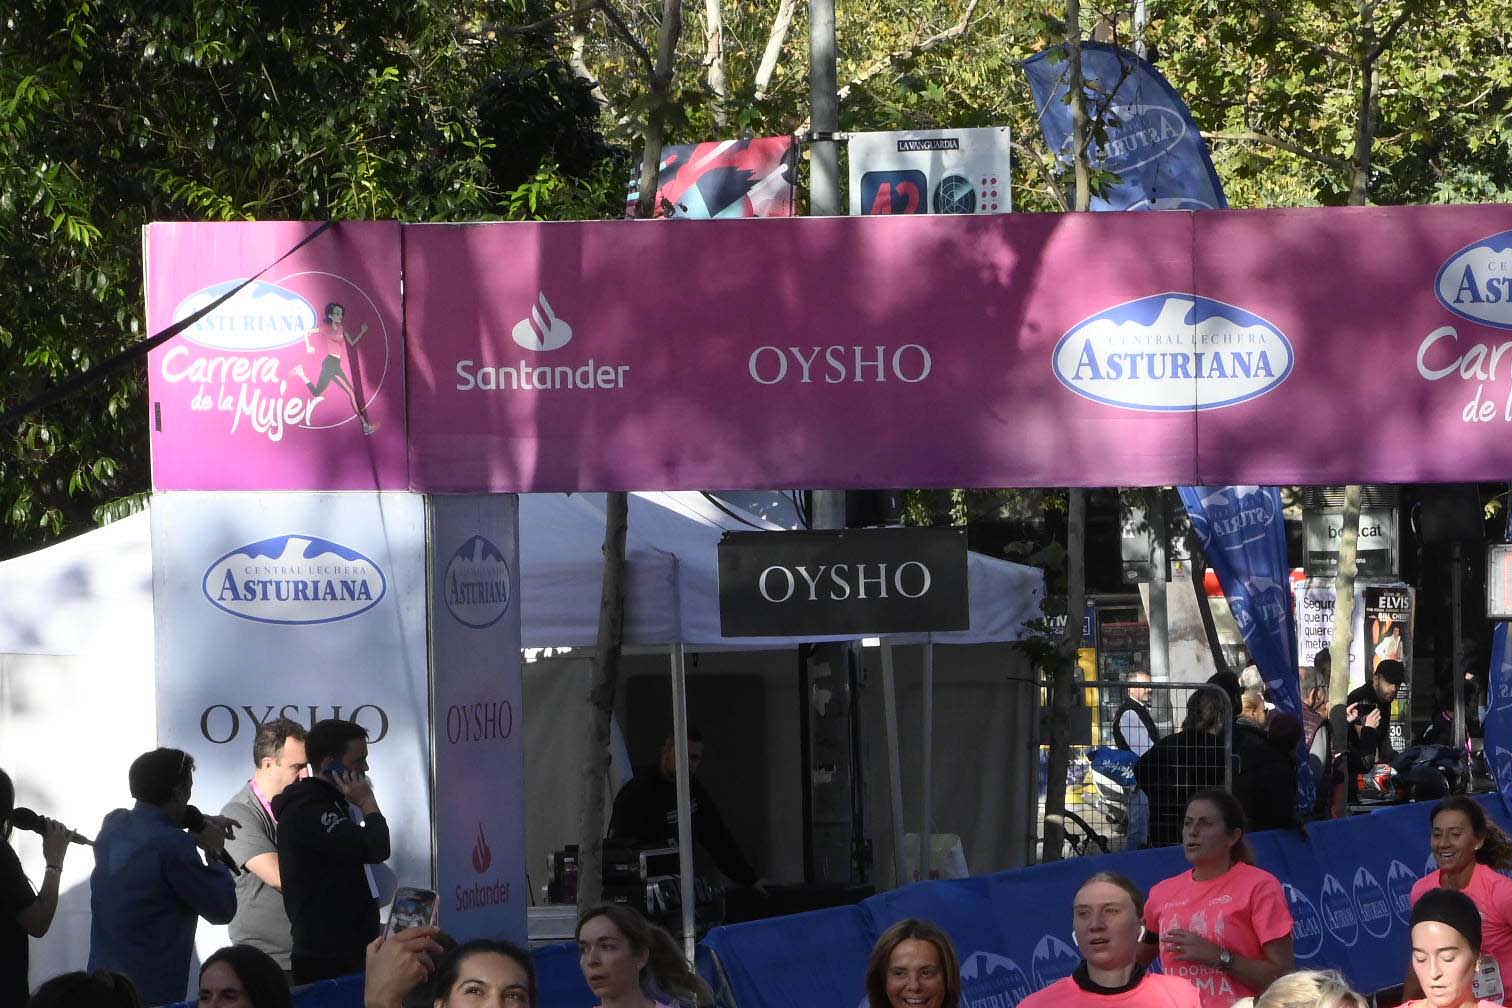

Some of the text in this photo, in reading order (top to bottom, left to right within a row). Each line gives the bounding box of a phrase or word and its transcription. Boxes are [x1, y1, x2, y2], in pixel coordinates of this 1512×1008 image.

[1188, 332, 1267, 345] LECHERA
[161, 345, 283, 385] Carrera
[456, 360, 630, 391] Santander
[748, 343, 933, 385] OYSHO
[1071, 337, 1275, 380] ASTURIANA
[191, 381, 325, 442] de la Mujer
[1462, 387, 1497, 423] de
[217, 568, 373, 602] ASTURIANA
[244, 564, 367, 576] CENTRAL LECHERA
[758, 561, 932, 603] OYSHO
[451, 568, 508, 607] ASTURIANA
[1378, 597, 1409, 609] ELVIS
[1304, 613, 1320, 623] que
[447, 701, 513, 745] OYSHO
[1389, 725, 1402, 737] 30
[455, 881, 511, 912] Santander
[1195, 977, 1235, 996] MA
